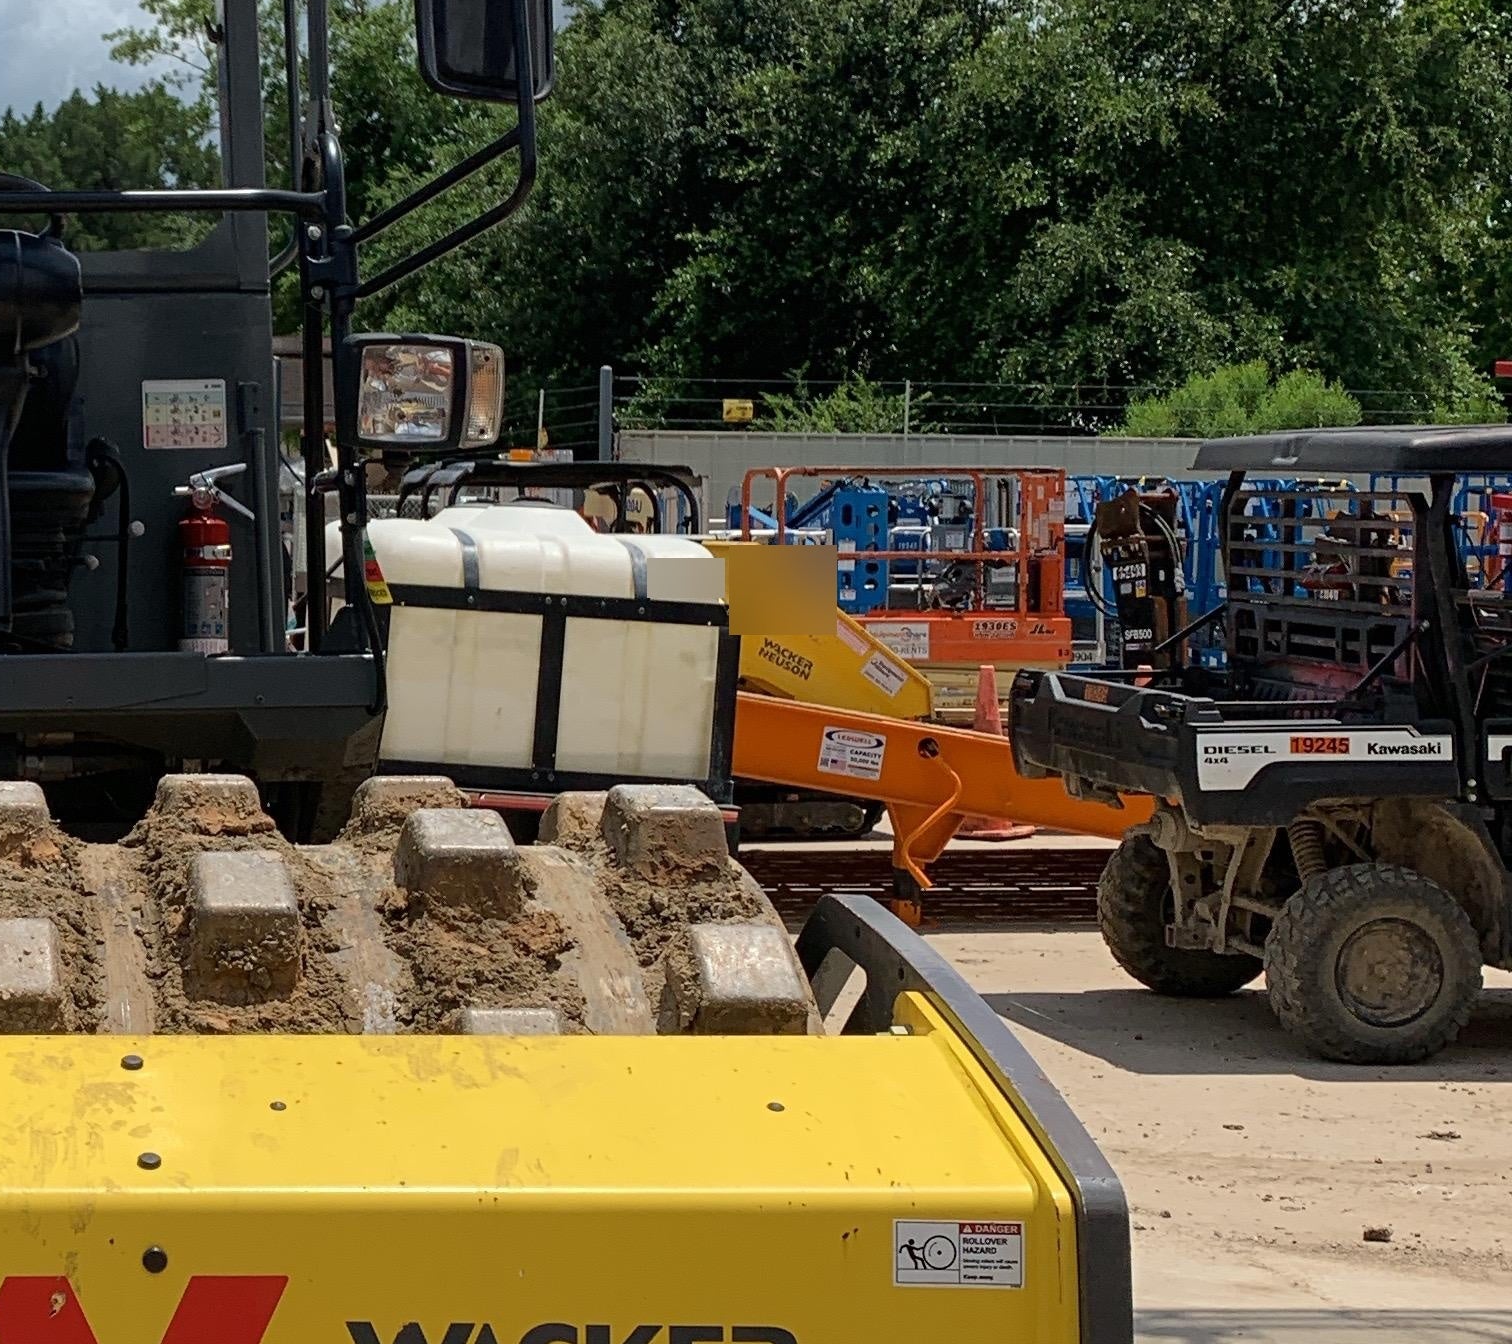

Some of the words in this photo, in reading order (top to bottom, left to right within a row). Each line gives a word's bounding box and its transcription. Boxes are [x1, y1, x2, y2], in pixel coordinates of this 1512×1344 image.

[1125, 629, 1152, 641] SFB500
[764, 637, 813, 670] WACKER
[759, 647, 811, 680] NEUSON
[1203, 745, 1277, 755] DIESEL
[1292, 737, 1351, 754] 19245
[1367, 742, 1442, 755] Kawasaki
[849, 749, 882, 759] CAPACITY
[1204, 757, 1229, 765] 4x4
[974, 1225, 1018, 1234] DANGER
[963, 1237, 1008, 1245] ROLLOVER
